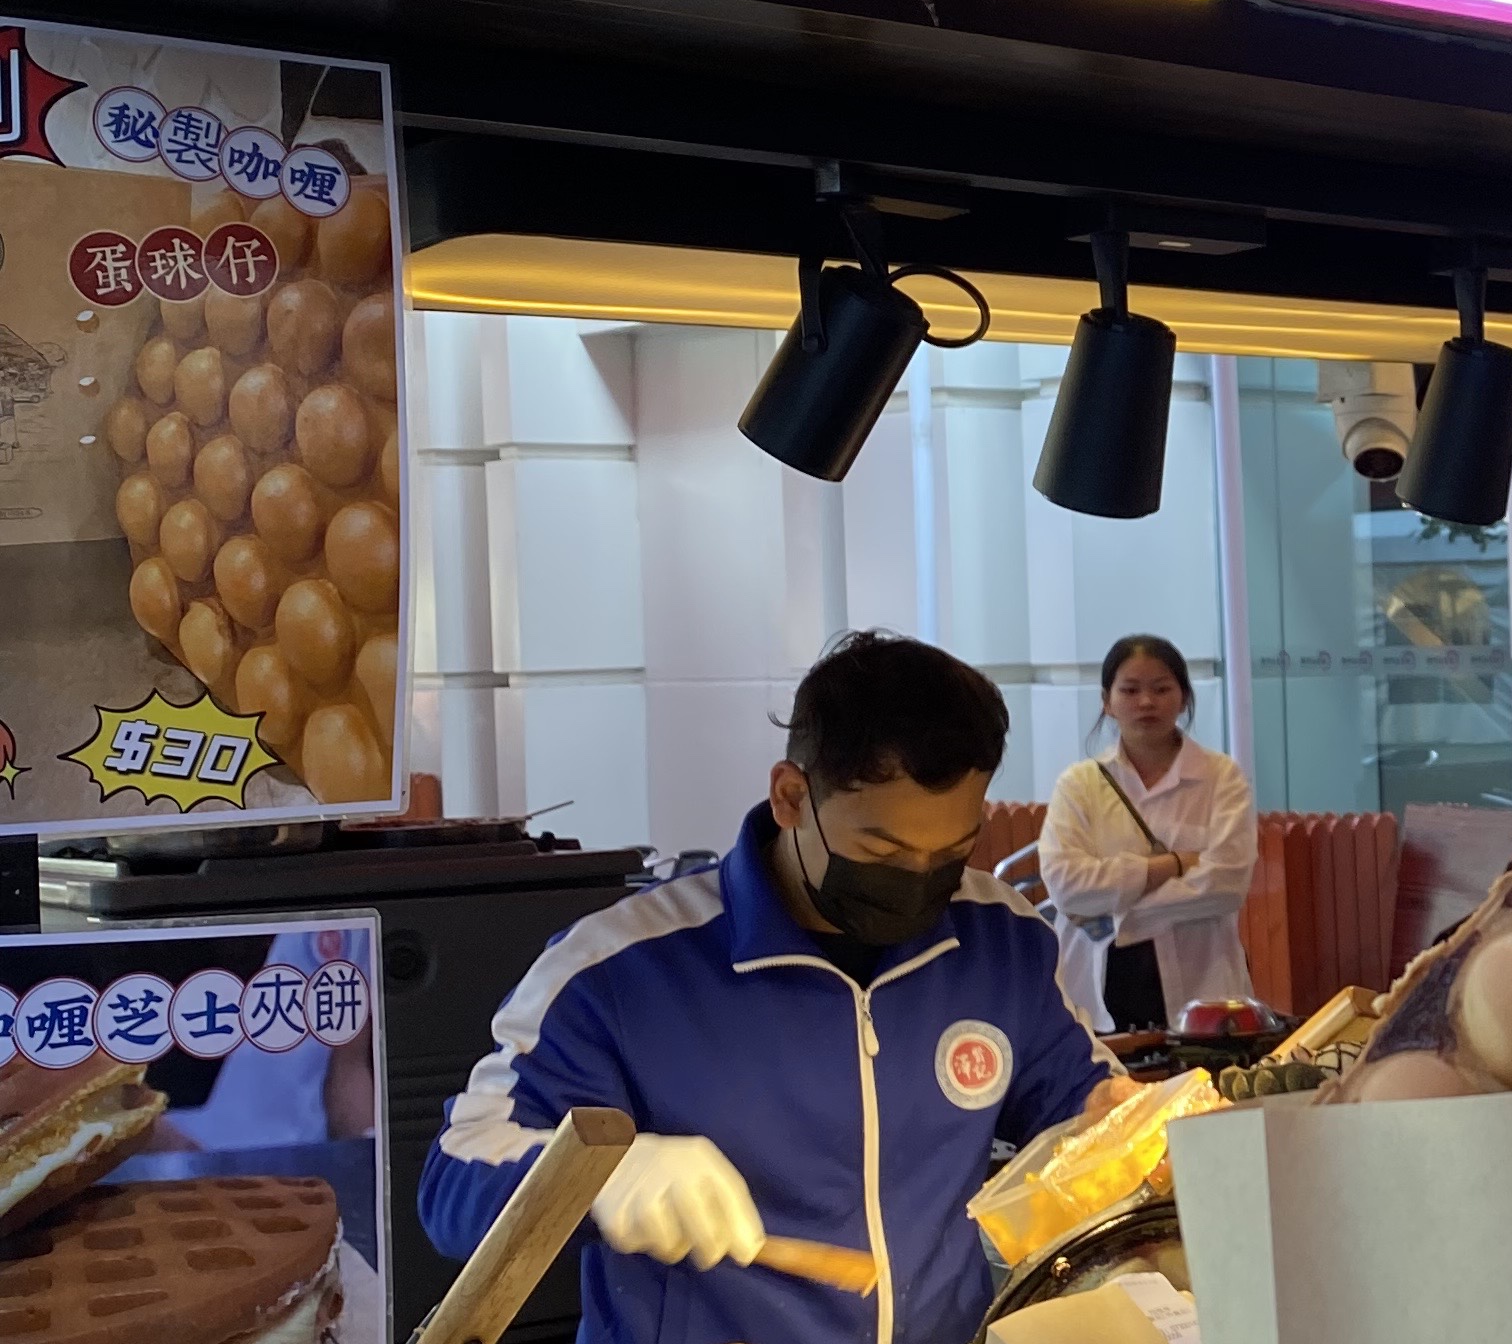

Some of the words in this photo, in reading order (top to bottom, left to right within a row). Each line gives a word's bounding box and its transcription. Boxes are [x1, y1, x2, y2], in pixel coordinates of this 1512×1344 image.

[102, 101, 341, 207] 秘製咖喱
[83, 235, 269, 295] 蛋球仔
[102, 718, 252, 786] $30
